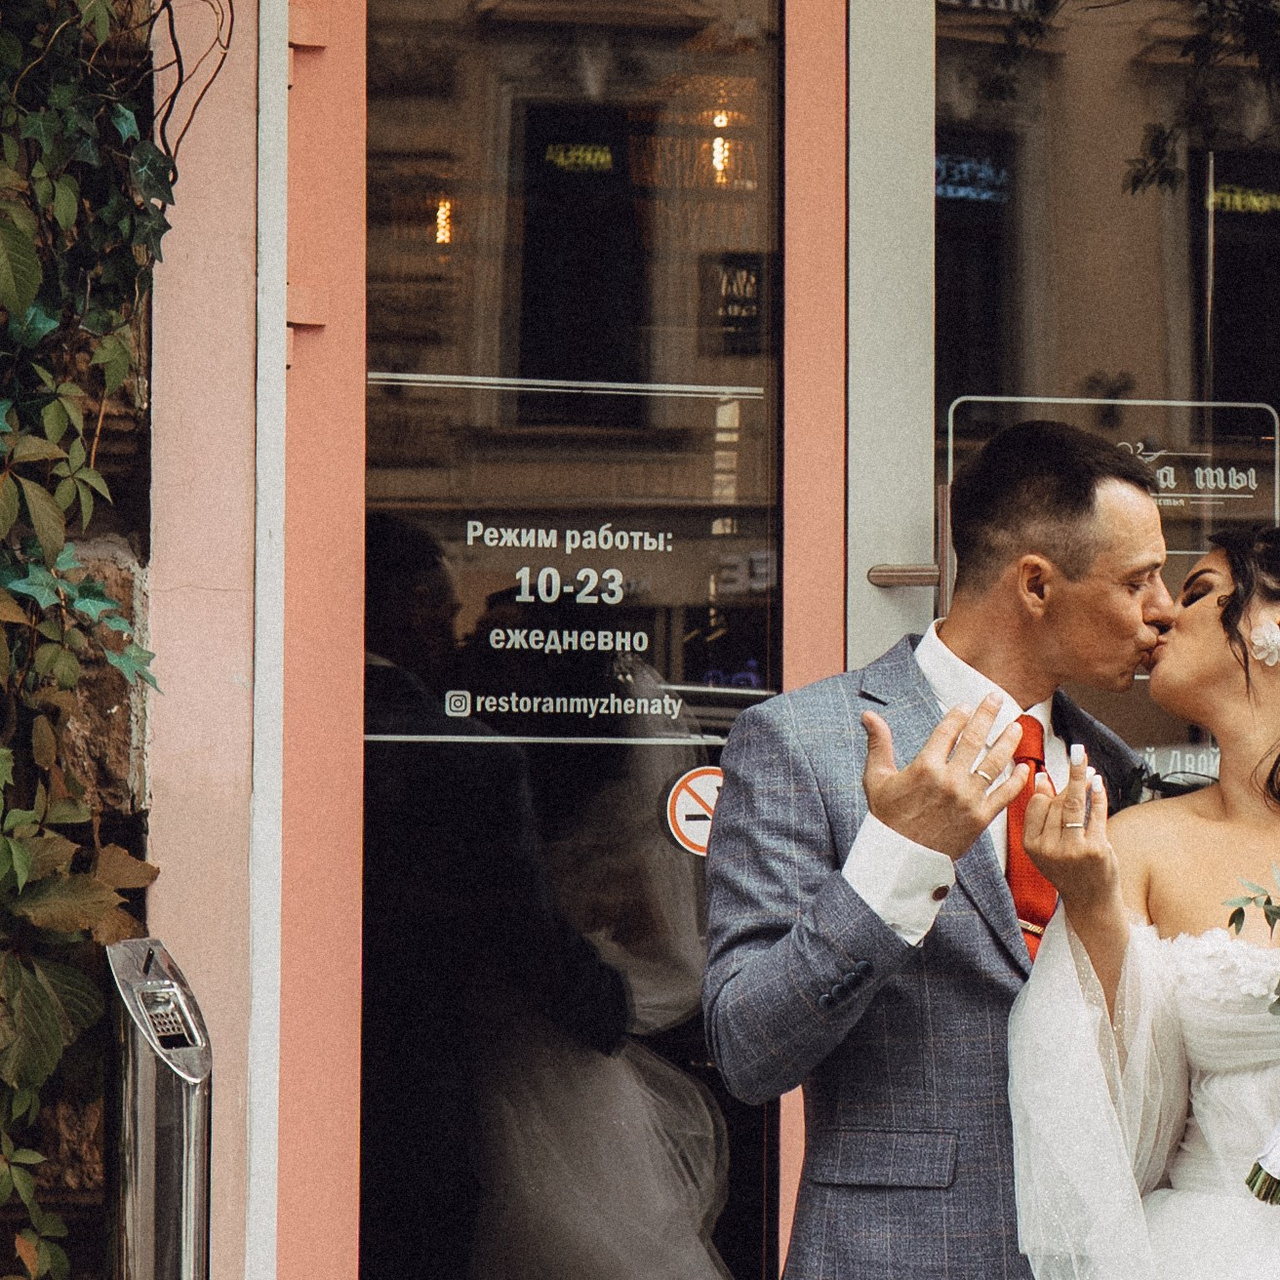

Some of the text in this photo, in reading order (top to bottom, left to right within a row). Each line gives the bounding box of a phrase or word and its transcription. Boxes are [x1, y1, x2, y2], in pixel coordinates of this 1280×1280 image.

[1194, 466, 1258, 491] ты
[466, 521, 673, 554] Режим работы:
[514, 566, 624, 604] 10-23
[489, 628, 649, 654] ежедневно
[475, 692, 683, 719] restoranmyzhenaty
